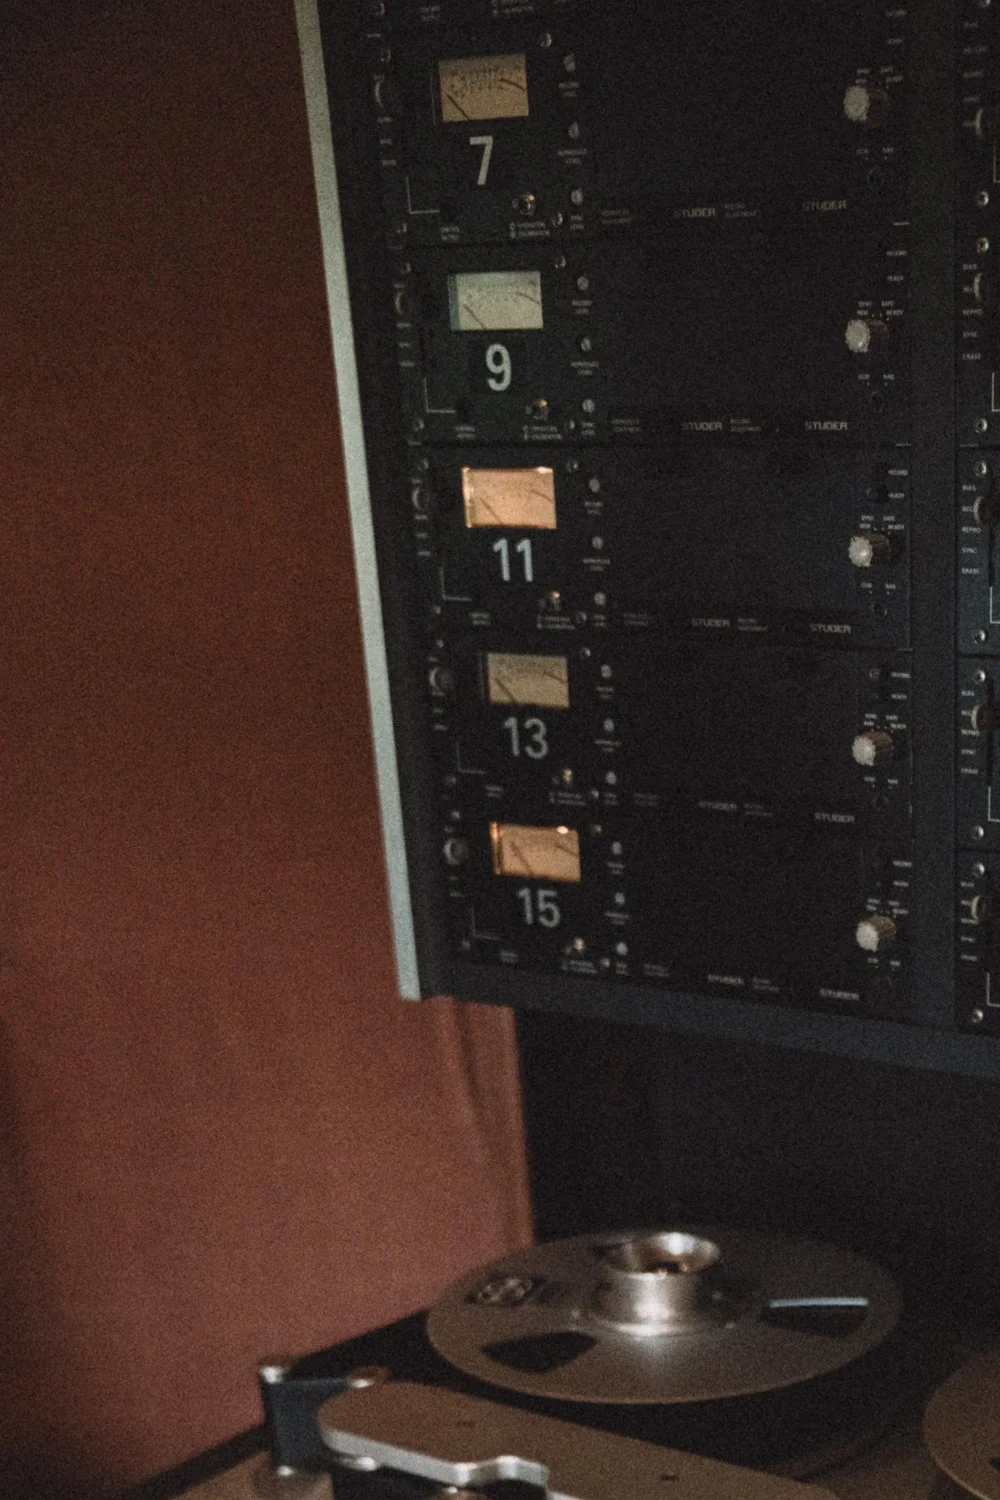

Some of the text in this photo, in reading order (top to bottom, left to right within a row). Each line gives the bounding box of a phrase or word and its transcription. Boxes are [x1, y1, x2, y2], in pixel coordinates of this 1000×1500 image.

[469, 135, 494, 186] 7
[485, 343, 512, 392] 9
[804, 421, 848, 431] STUDER
[492, 537, 534, 583] 11
[503, 716, 549, 760] 13
[517, 887, 561, 928] 15
